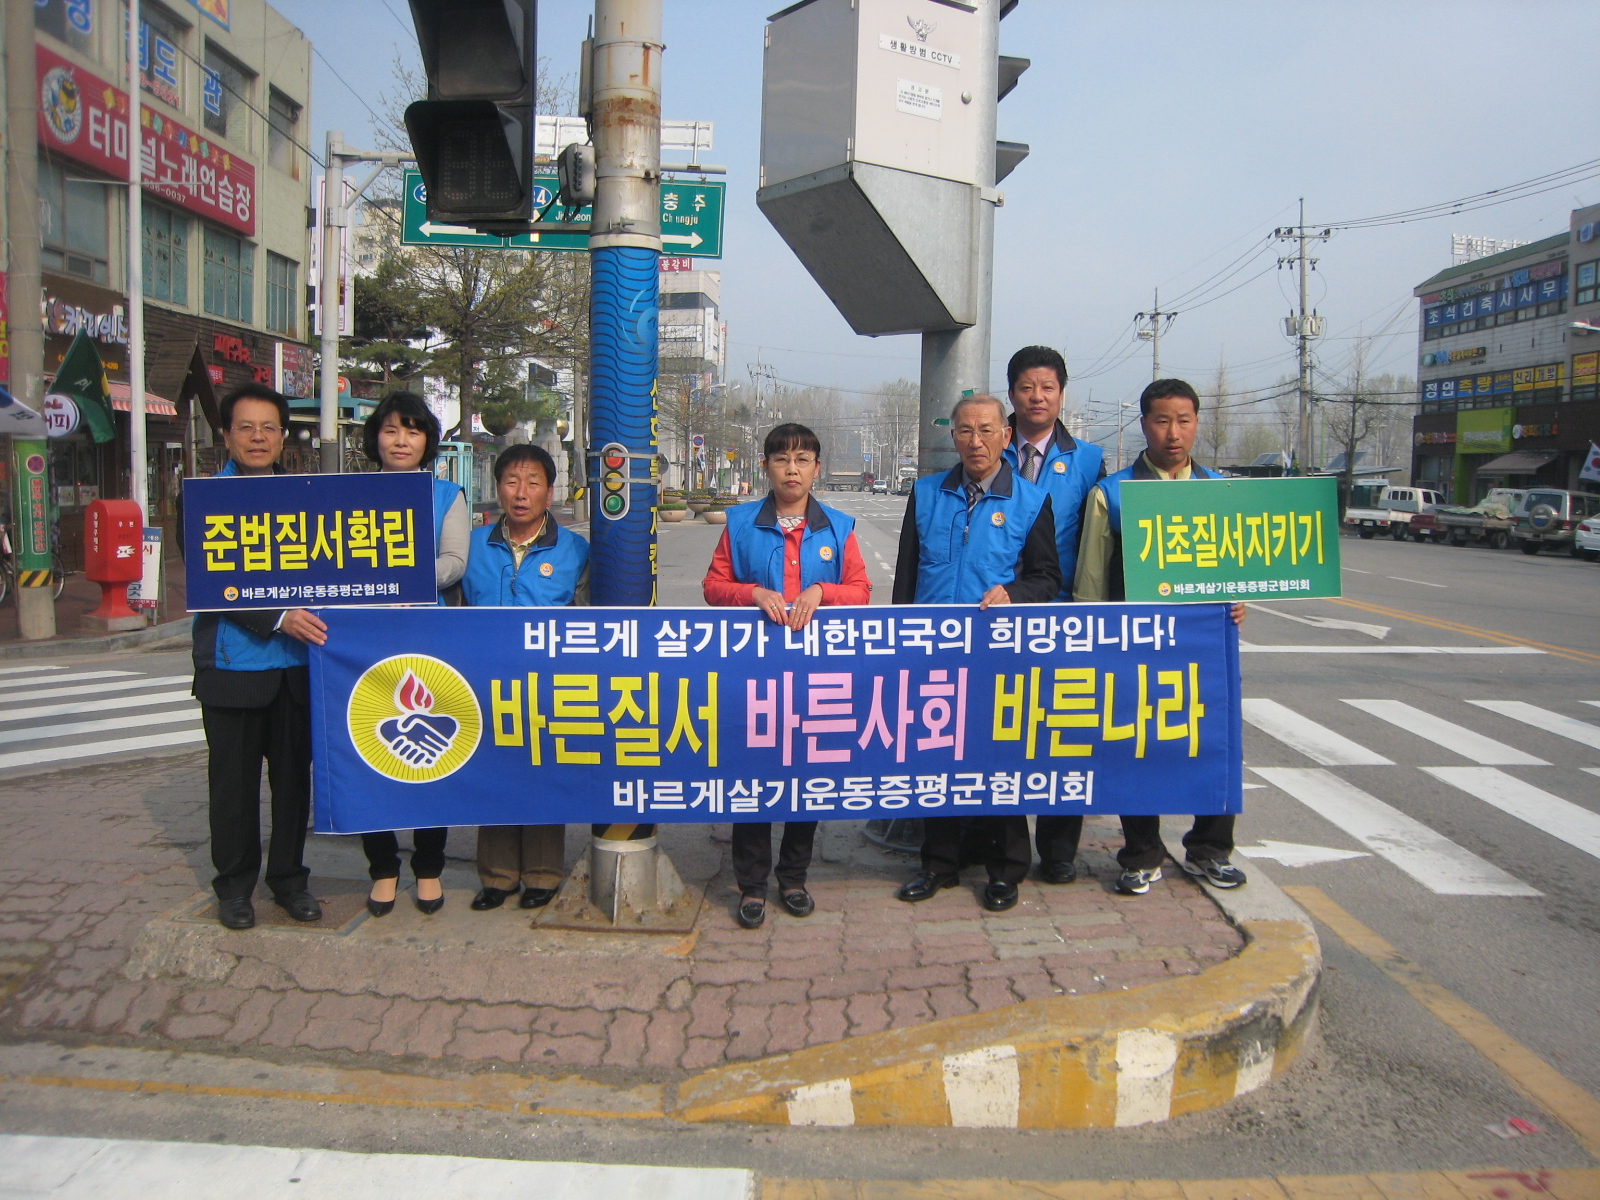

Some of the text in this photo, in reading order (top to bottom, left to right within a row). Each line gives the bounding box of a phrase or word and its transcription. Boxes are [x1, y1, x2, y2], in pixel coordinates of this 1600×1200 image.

[890, 39, 953, 64] 생활방범 CCTV
[662, 193, 706, 213] 충주
[662, 213, 699, 225] Chungju
[660, 258, 691, 271] 불갈비
[202, 508, 416, 572] 준법질서확립
[1138, 510, 1325, 570] 기초질서지키기
[241, 582, 400, 600] 바르게살기운동증평군협의회
[1173, 579, 1310, 595] 바르게살기운동증평군협의회
[523, 615, 1177, 658] 바르게 살기가 대한민국의 희망입니다!
[490, 662, 1205, 768] 바른질서 바른사회 바른나라
[612, 770, 1094, 814] 바르게살기운동증평군협의회
